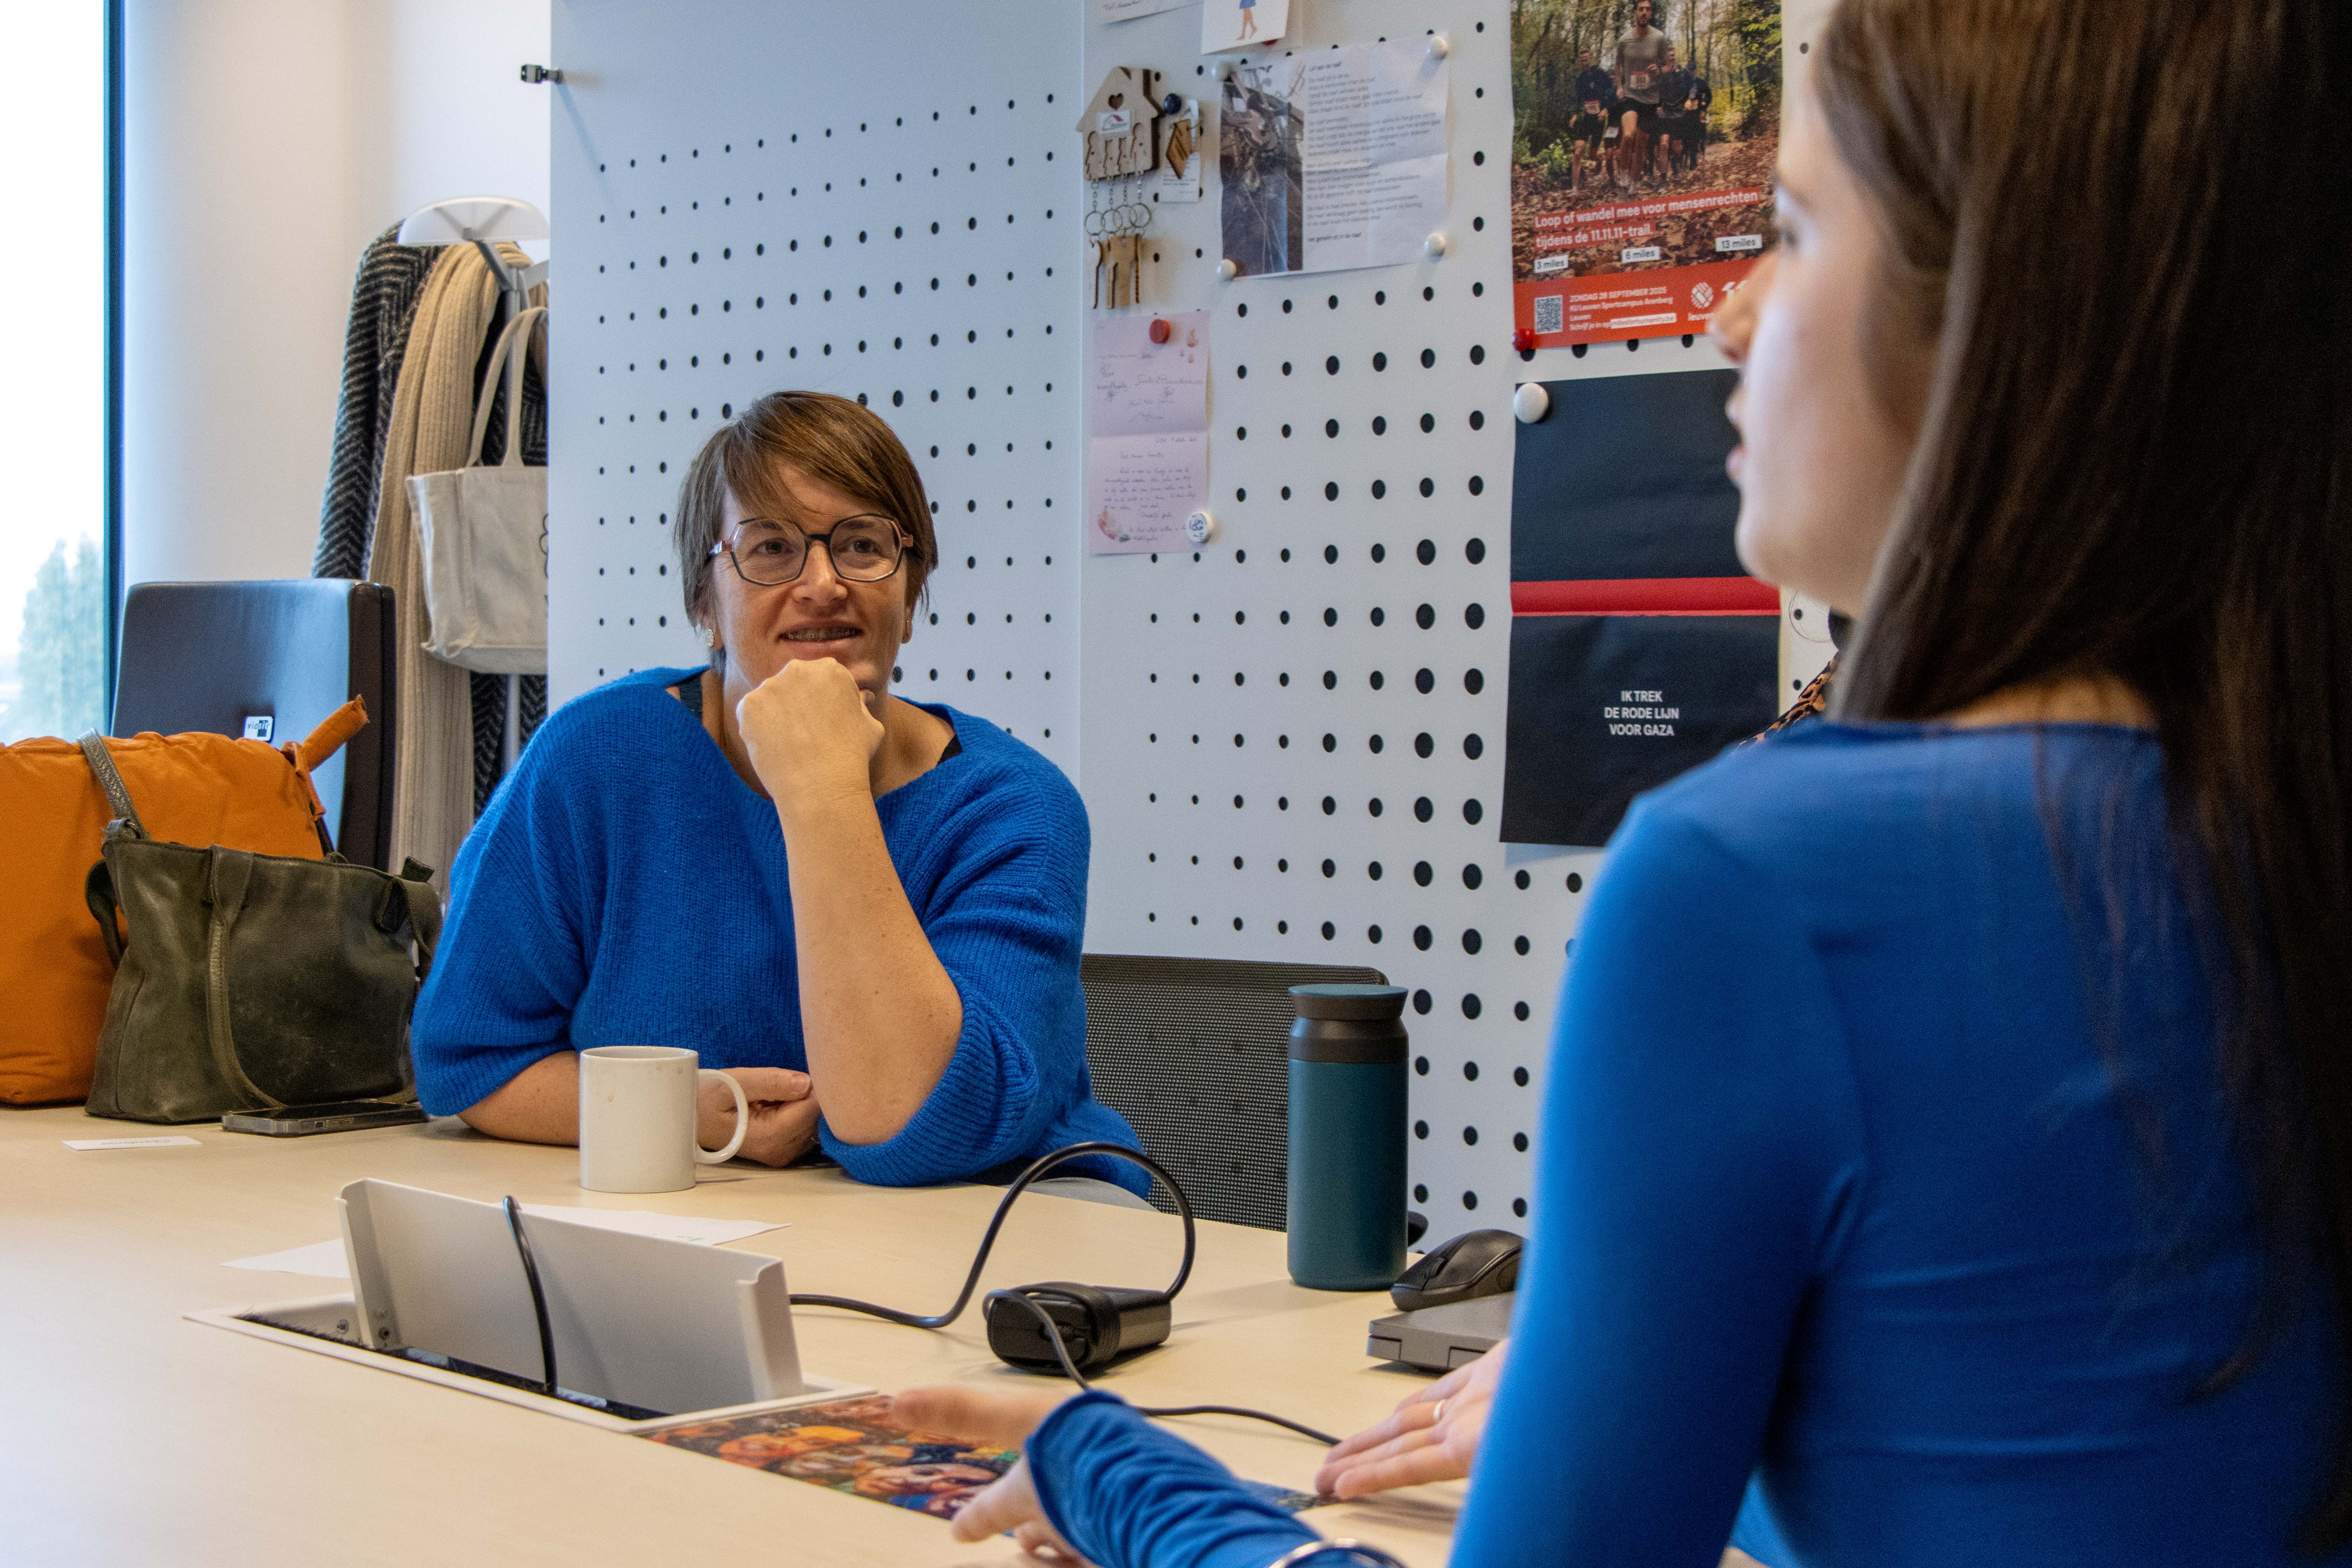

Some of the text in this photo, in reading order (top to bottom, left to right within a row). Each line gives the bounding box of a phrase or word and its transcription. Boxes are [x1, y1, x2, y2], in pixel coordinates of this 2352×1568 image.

[1535, 192, 1758, 228] Loop of wandel mee voor mensenrechten
[1536, 235, 1572, 250] tijdens
[1575, 232, 1589, 244] de
[1721, 238, 1756, 249] 13 miles
[1626, 250, 1655, 260] 6 miles
[1538, 259, 1564, 269] 3 miles
[1569, 293, 1598, 302] ZONDAG
[1609, 288, 1649, 299] SEPTEMBER
[1621, 690, 1663, 702] IK TREK
[1604, 707, 1679, 719] DE RODE LIJN
[1609, 724, 1675, 736] VOOR GAZA
